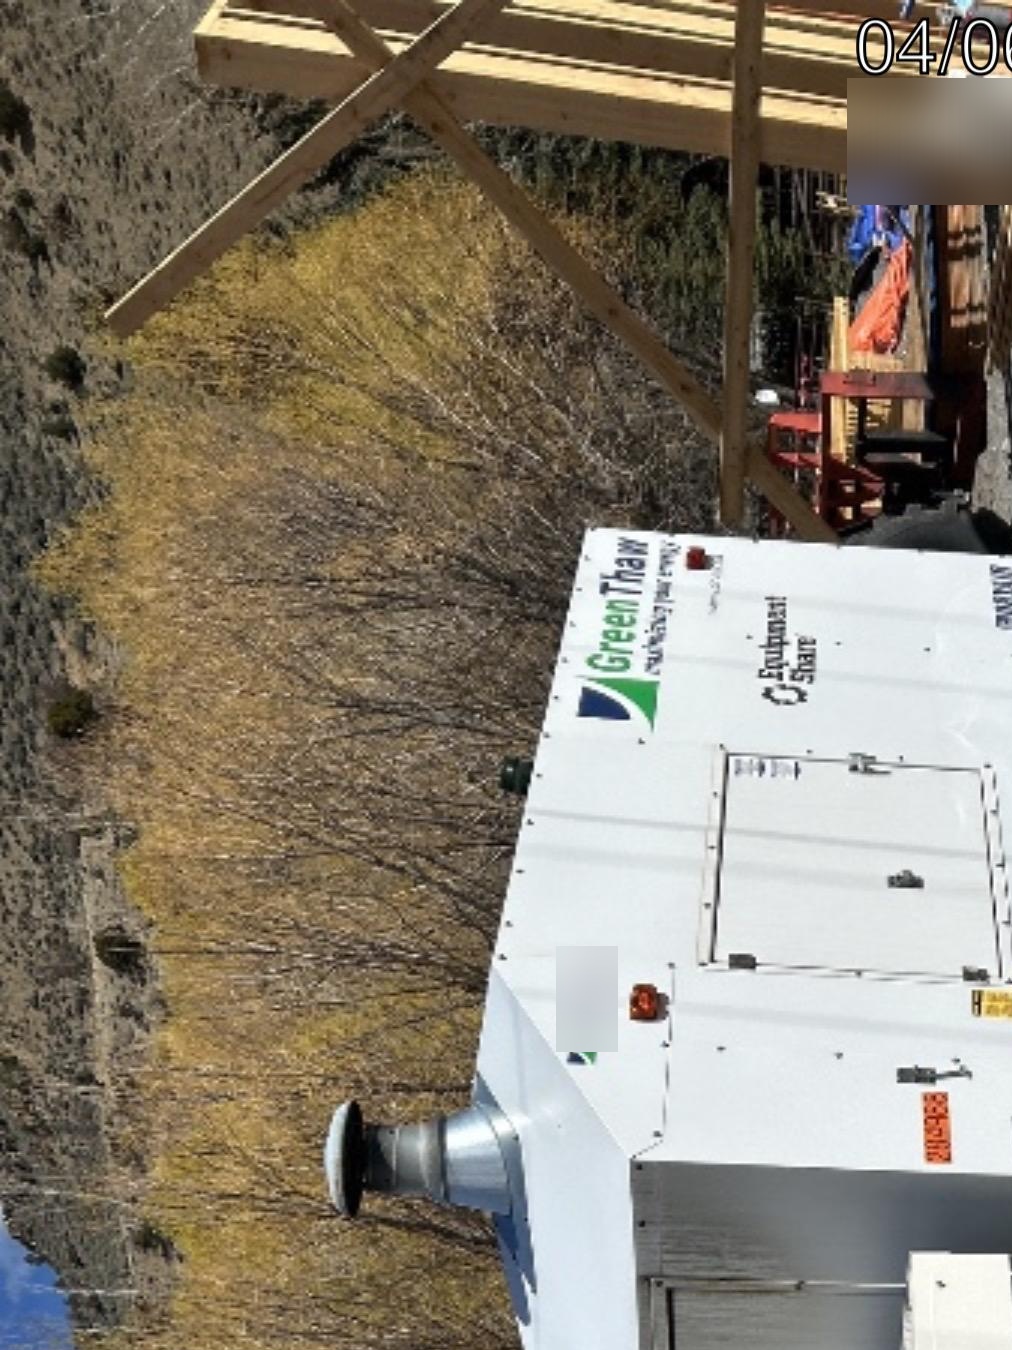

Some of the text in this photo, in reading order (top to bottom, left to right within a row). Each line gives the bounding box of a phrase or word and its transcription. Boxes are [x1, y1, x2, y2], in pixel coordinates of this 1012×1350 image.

[585, 534, 648, 672] GreenThaw
[758, 594, 789, 681] Equipment
[788, 636, 816, 683] Share
